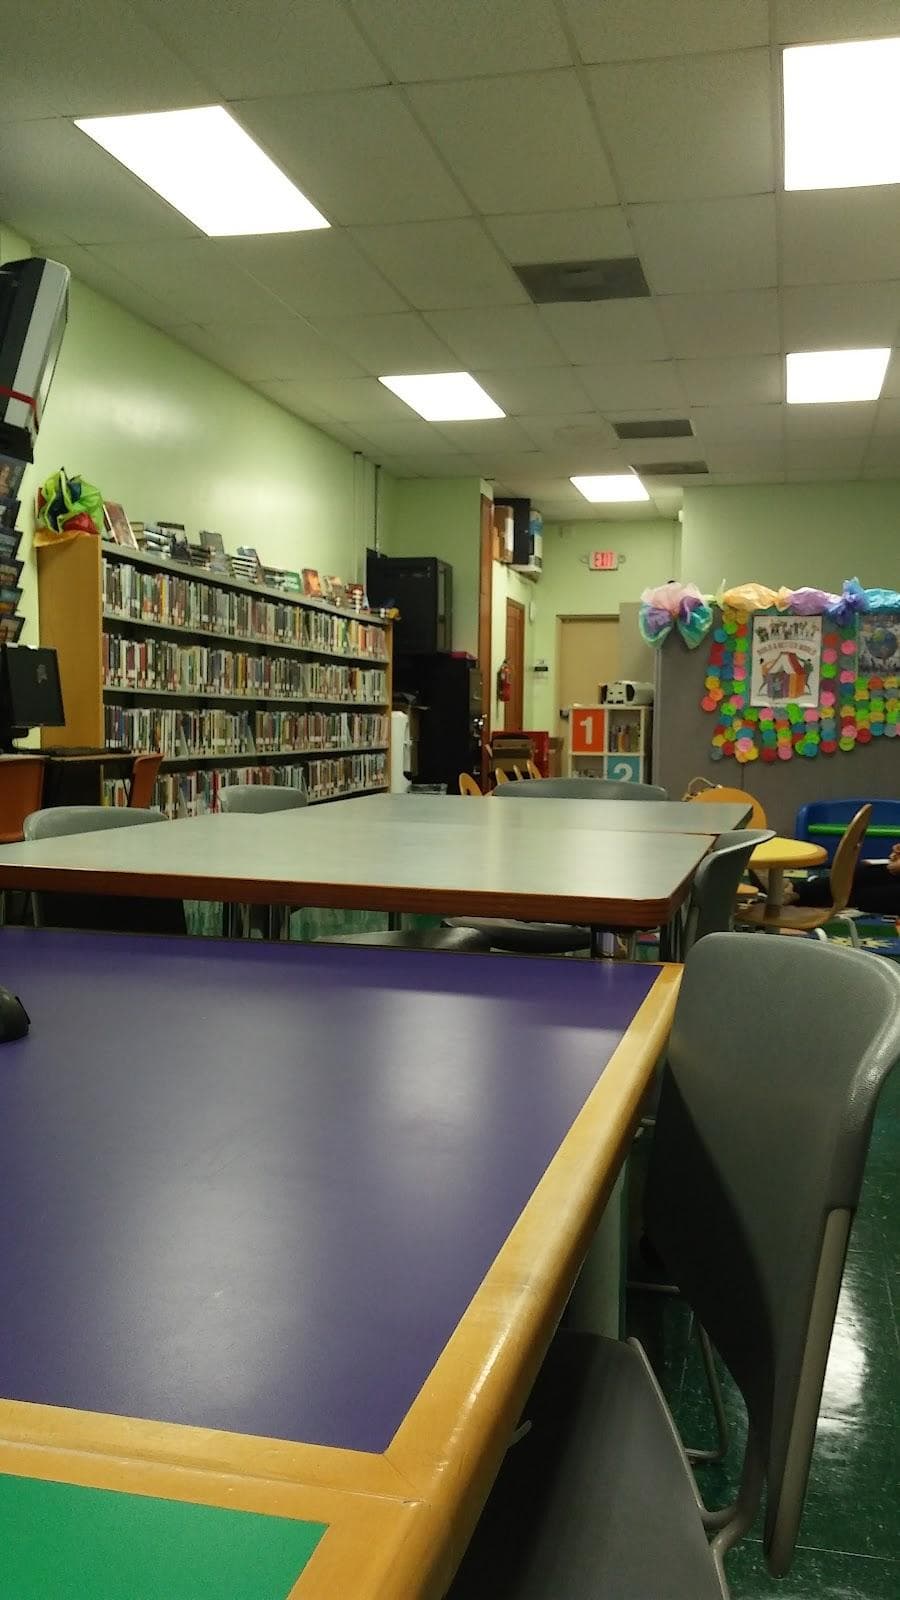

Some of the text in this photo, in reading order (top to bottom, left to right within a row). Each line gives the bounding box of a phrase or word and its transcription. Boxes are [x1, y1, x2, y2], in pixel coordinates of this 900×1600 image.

[594, 552, 614, 568] EXIT
[580, 716, 593, 745] 1
[614, 763, 633, 782] 2
